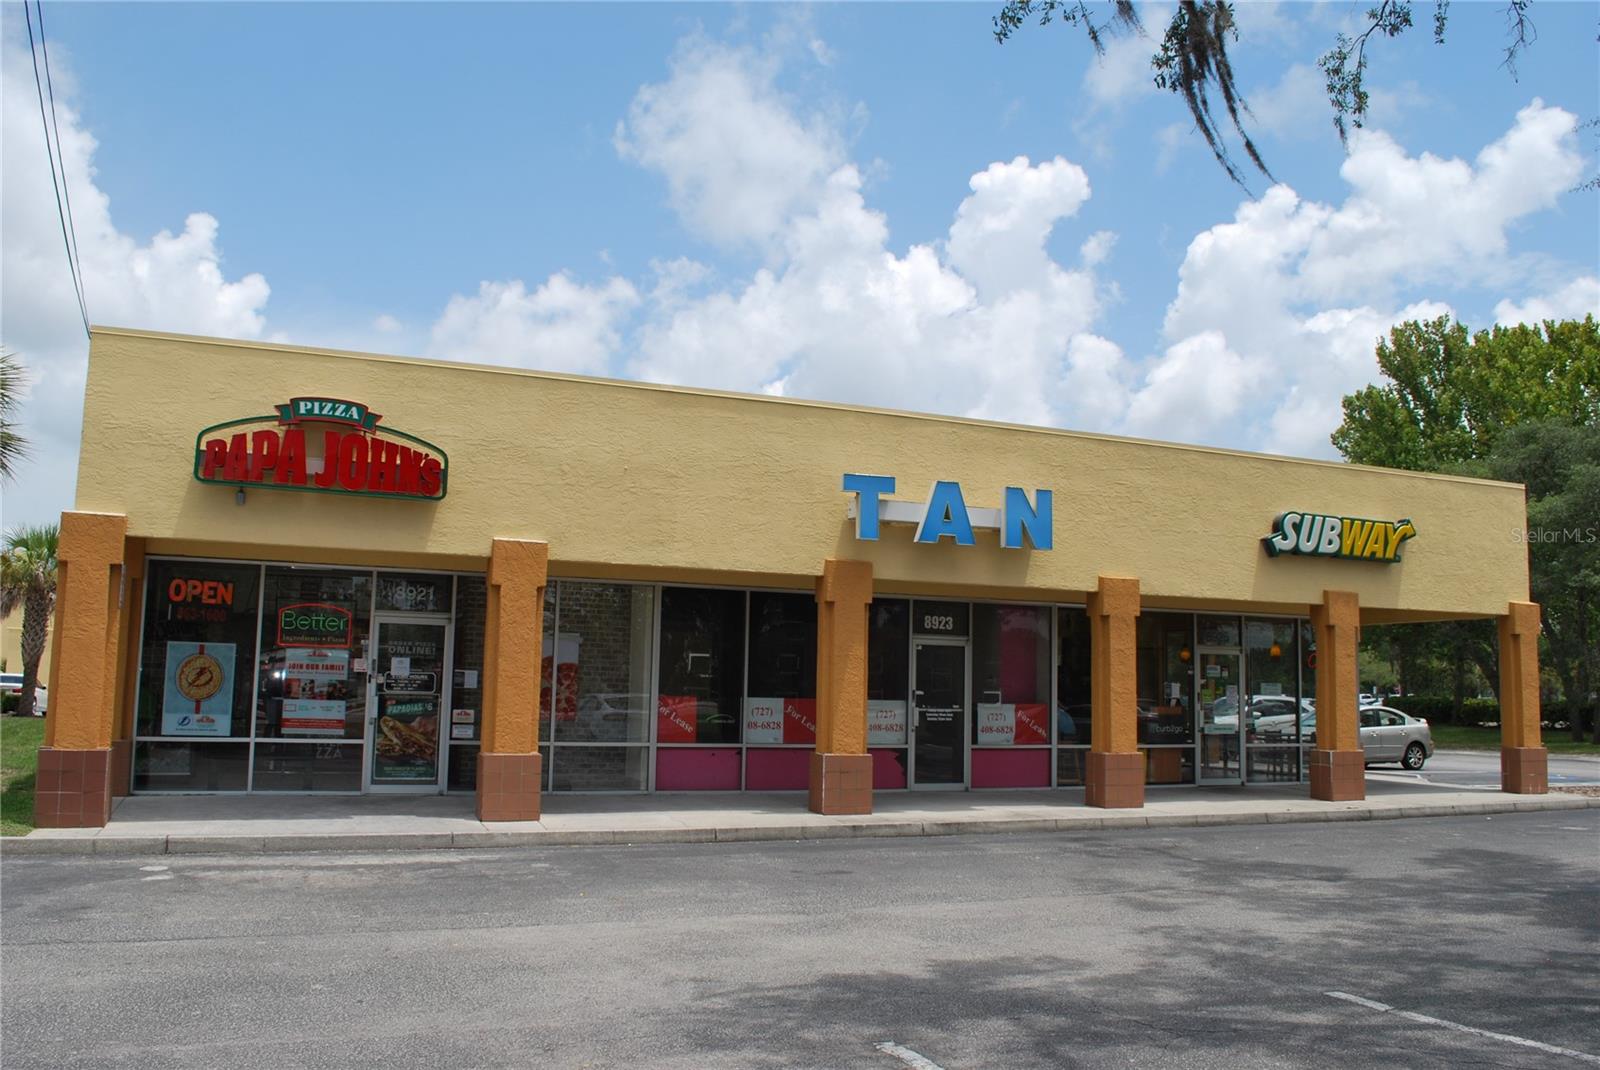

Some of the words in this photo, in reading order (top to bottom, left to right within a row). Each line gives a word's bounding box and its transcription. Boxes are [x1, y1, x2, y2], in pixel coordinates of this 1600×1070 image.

[299, 401, 360, 420] PIZZA
[203, 429, 307, 486] PAPA
[842, 473, 1053, 550] TAN
[1271, 512, 1415, 560] SUBWAY
[168, 578, 235, 606] OPEN
[396, 586, 435, 601] 8921
[281, 610, 349, 631] Better
[924, 615, 954, 630] 8923
[305, 663, 320, 671] OUR
[751, 706, 773, 717] (727)
[785, 704, 801, 720] For
[876, 709, 896, 720] (727)
[987, 712, 1006, 721] (727)
[1017, 709, 1029, 724] For
[670, 711, 694, 733] Lease
[747, 720, 781, 730] 08-6828
